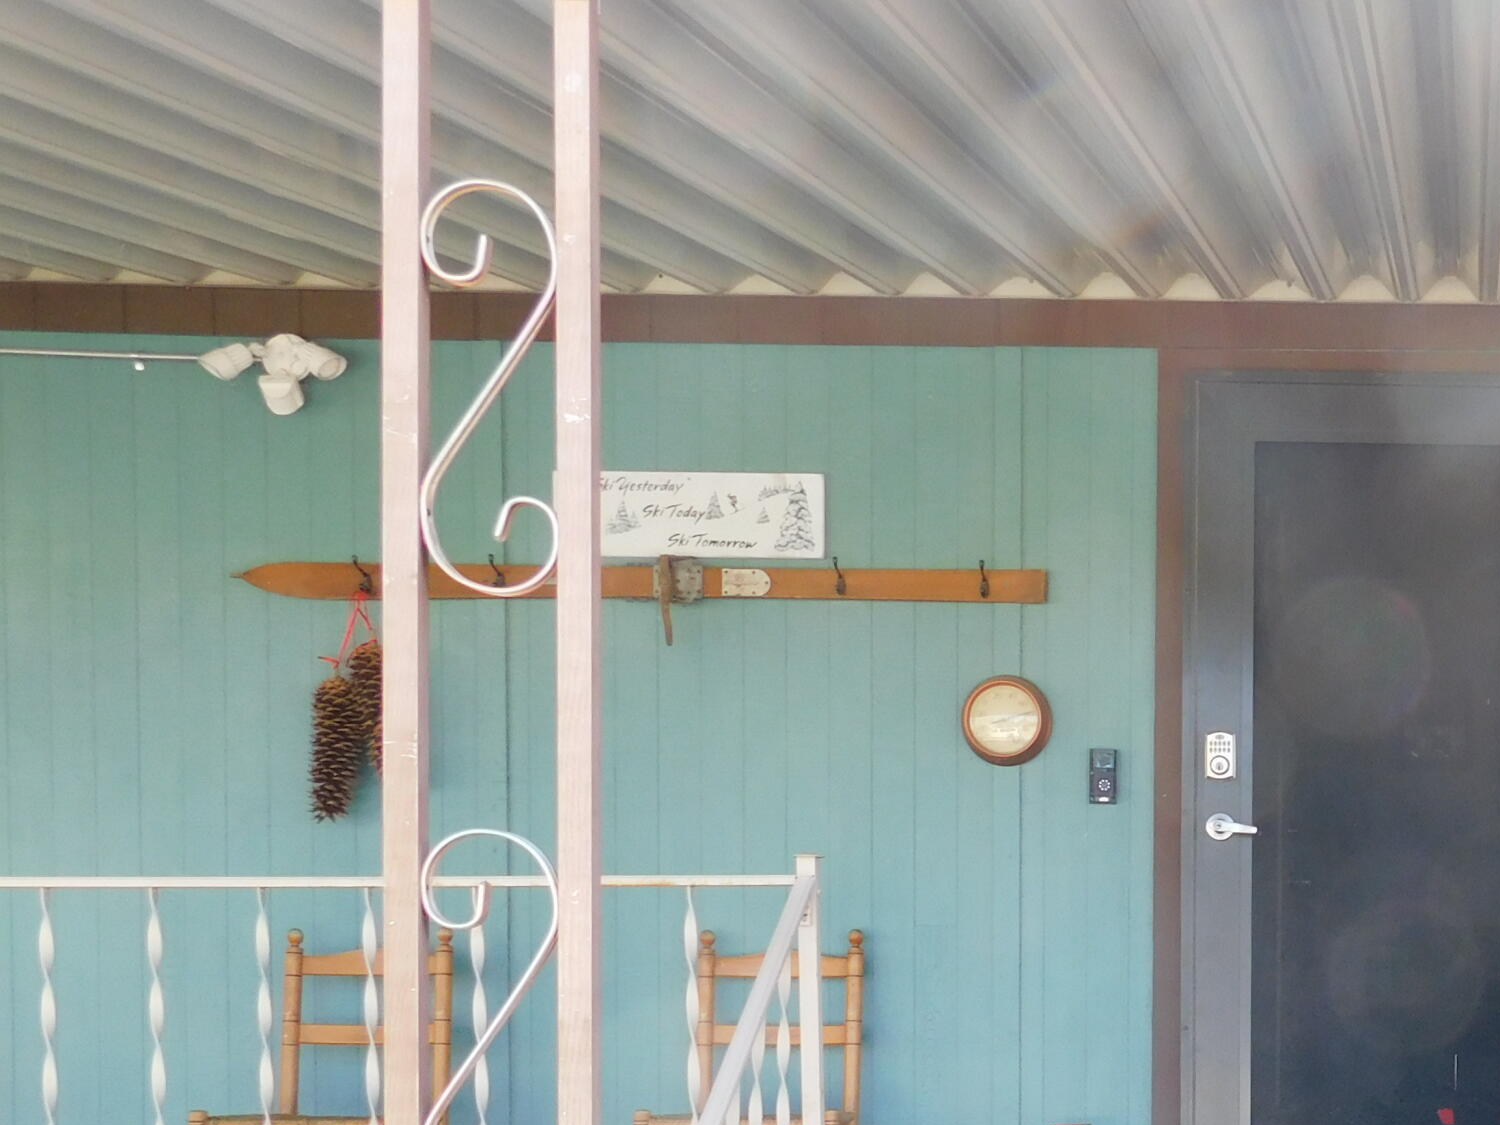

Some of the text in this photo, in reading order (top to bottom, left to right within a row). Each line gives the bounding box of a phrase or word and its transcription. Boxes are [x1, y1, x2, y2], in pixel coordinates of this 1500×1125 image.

[642, 504, 706, 525] Ski Today
[667, 533, 758, 549] Ski Tomorrow
